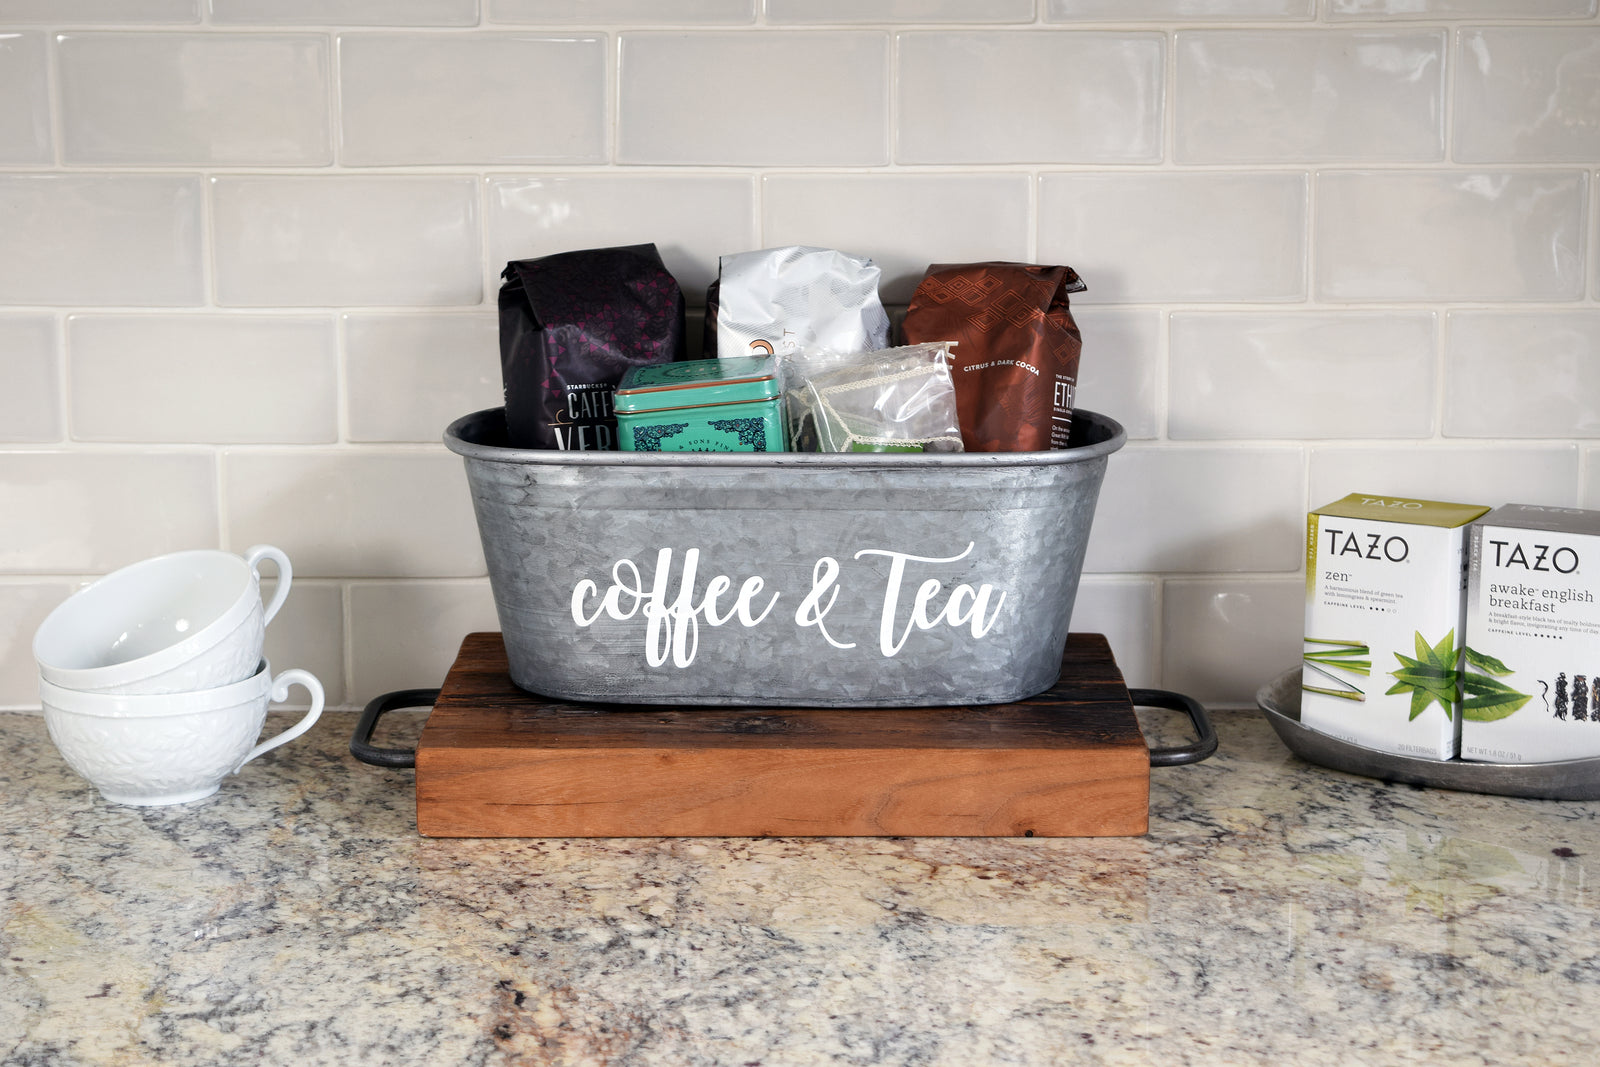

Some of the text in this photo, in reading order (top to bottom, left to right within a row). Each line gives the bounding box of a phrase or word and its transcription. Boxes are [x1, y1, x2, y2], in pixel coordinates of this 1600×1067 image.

[963, 362, 989, 372] CITRUS
[1015, 360, 1040, 376] COCOA
[554, 425, 620, 450] VER
[715, 441, 733, 451] FIN
[1361, 498, 1423, 510] TAZO
[1325, 528, 1409, 563] TAZO
[1489, 540, 1579, 574] TAZO
[1325, 571, 1348, 581] zen
[1490, 583, 1594, 603] awake english
[571, 541, 1007, 668] coffee & Tea
[1489, 595, 1555, 613] breakfast
[1487, 627, 1514, 635] CAFFEINE
[1466, 746, 1477, 754] NET
